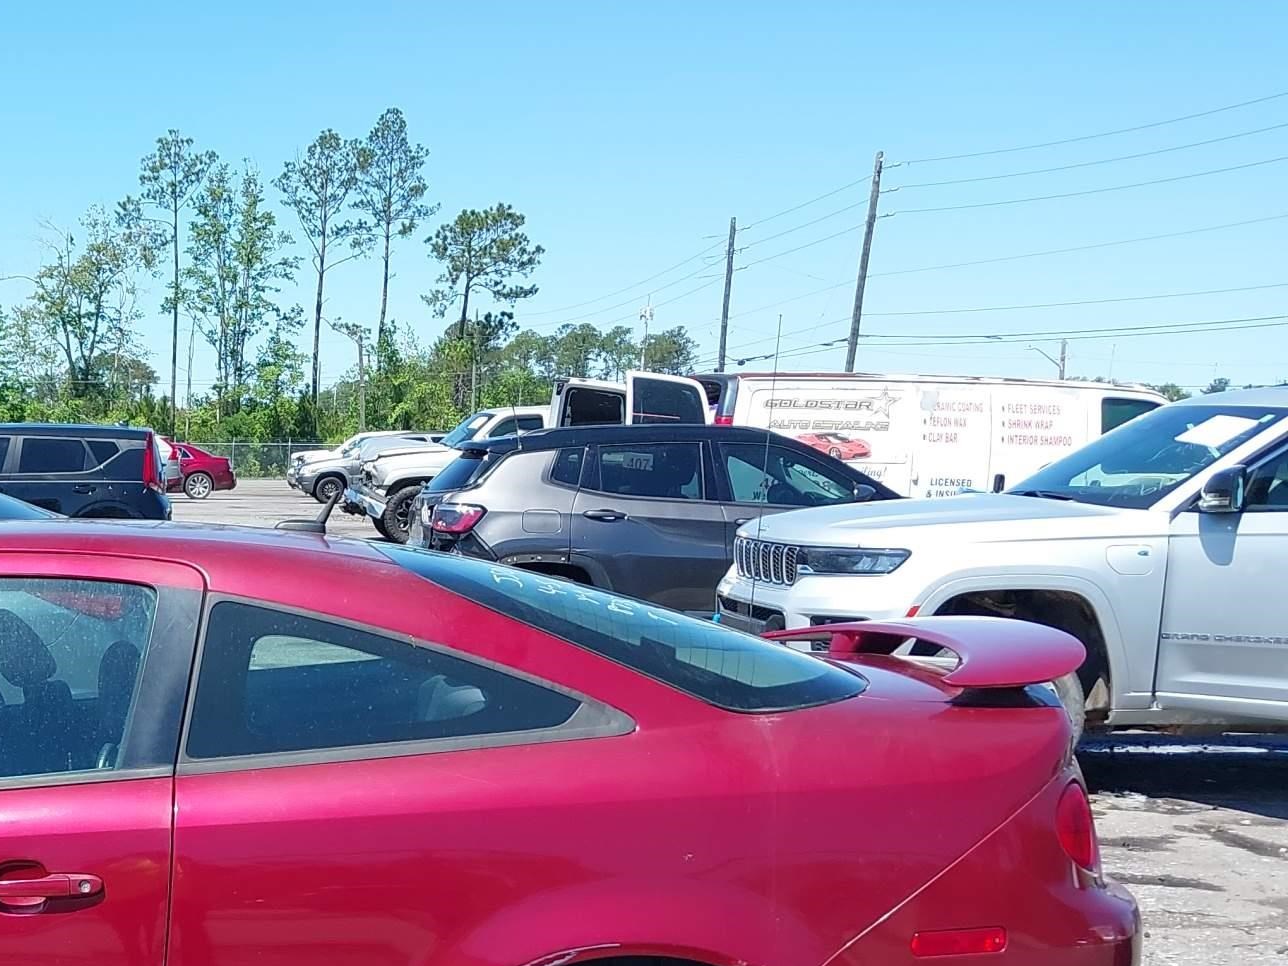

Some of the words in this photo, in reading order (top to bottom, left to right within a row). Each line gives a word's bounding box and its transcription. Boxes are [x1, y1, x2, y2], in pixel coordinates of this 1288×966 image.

[764, 398, 873, 411] GOLDSTAR
[1007, 403, 1028, 414] FLEET
[1029, 404, 1061, 415] SERVICES
[769, 418, 811, 430] AUTO
[929, 416, 952, 427] TEFLON
[1007, 419, 1033, 429] SHRINK
[1035, 419, 1054, 430] WRAP
[928, 432, 944, 443] CLAY
[945, 432, 958, 444] BAR
[1007, 434, 1039, 446] INTERIOR
[1040, 435, 1073, 447] SHAMPOO
[930, 478, 972, 488] LICENSED
